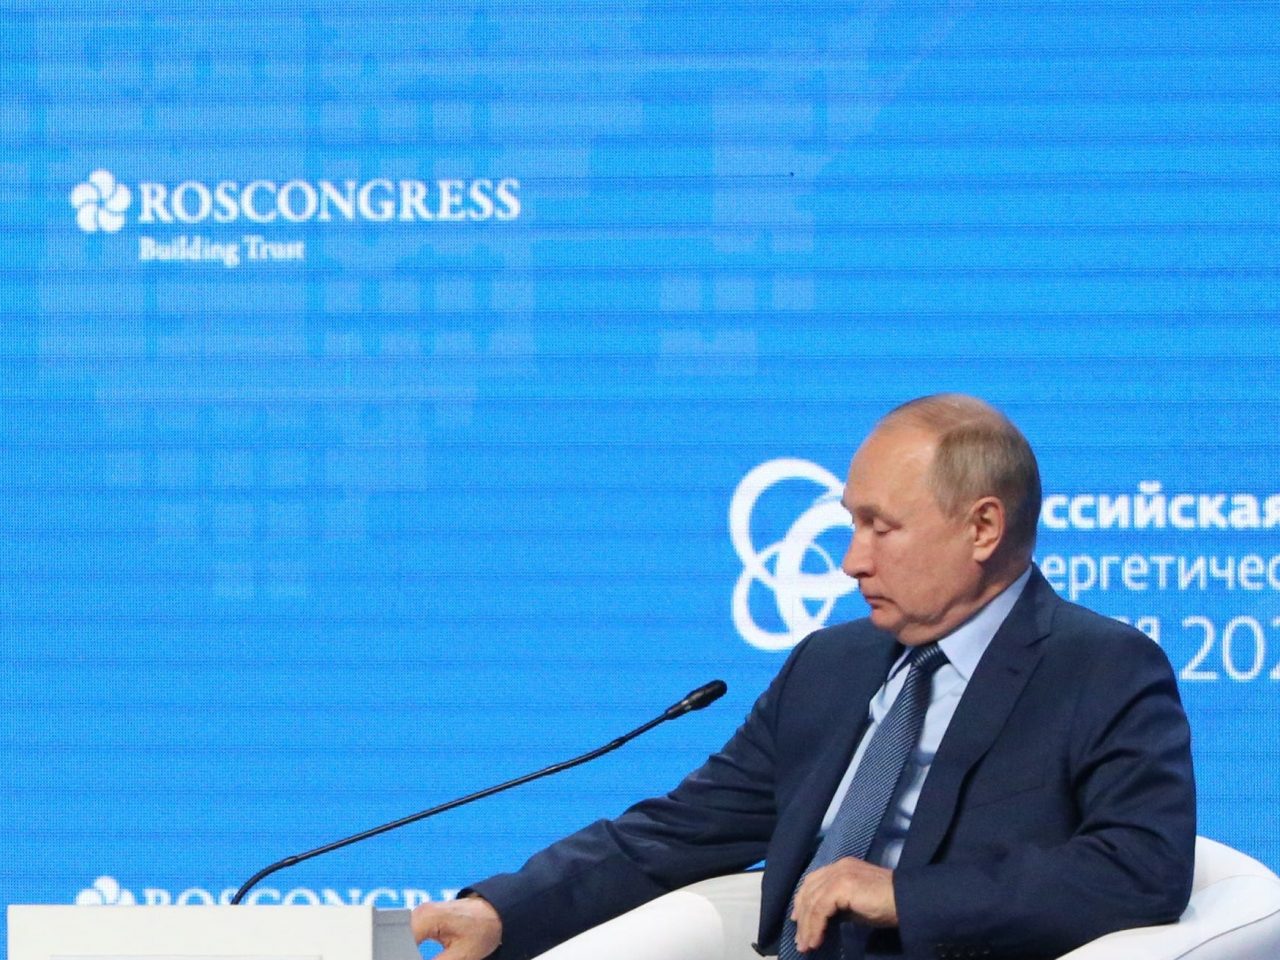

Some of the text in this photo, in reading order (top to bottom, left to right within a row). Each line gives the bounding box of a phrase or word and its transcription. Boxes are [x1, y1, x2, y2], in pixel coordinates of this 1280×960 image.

[138, 178, 521, 223] ROSCONGRESS
[139, 235, 305, 268] Building Trust
